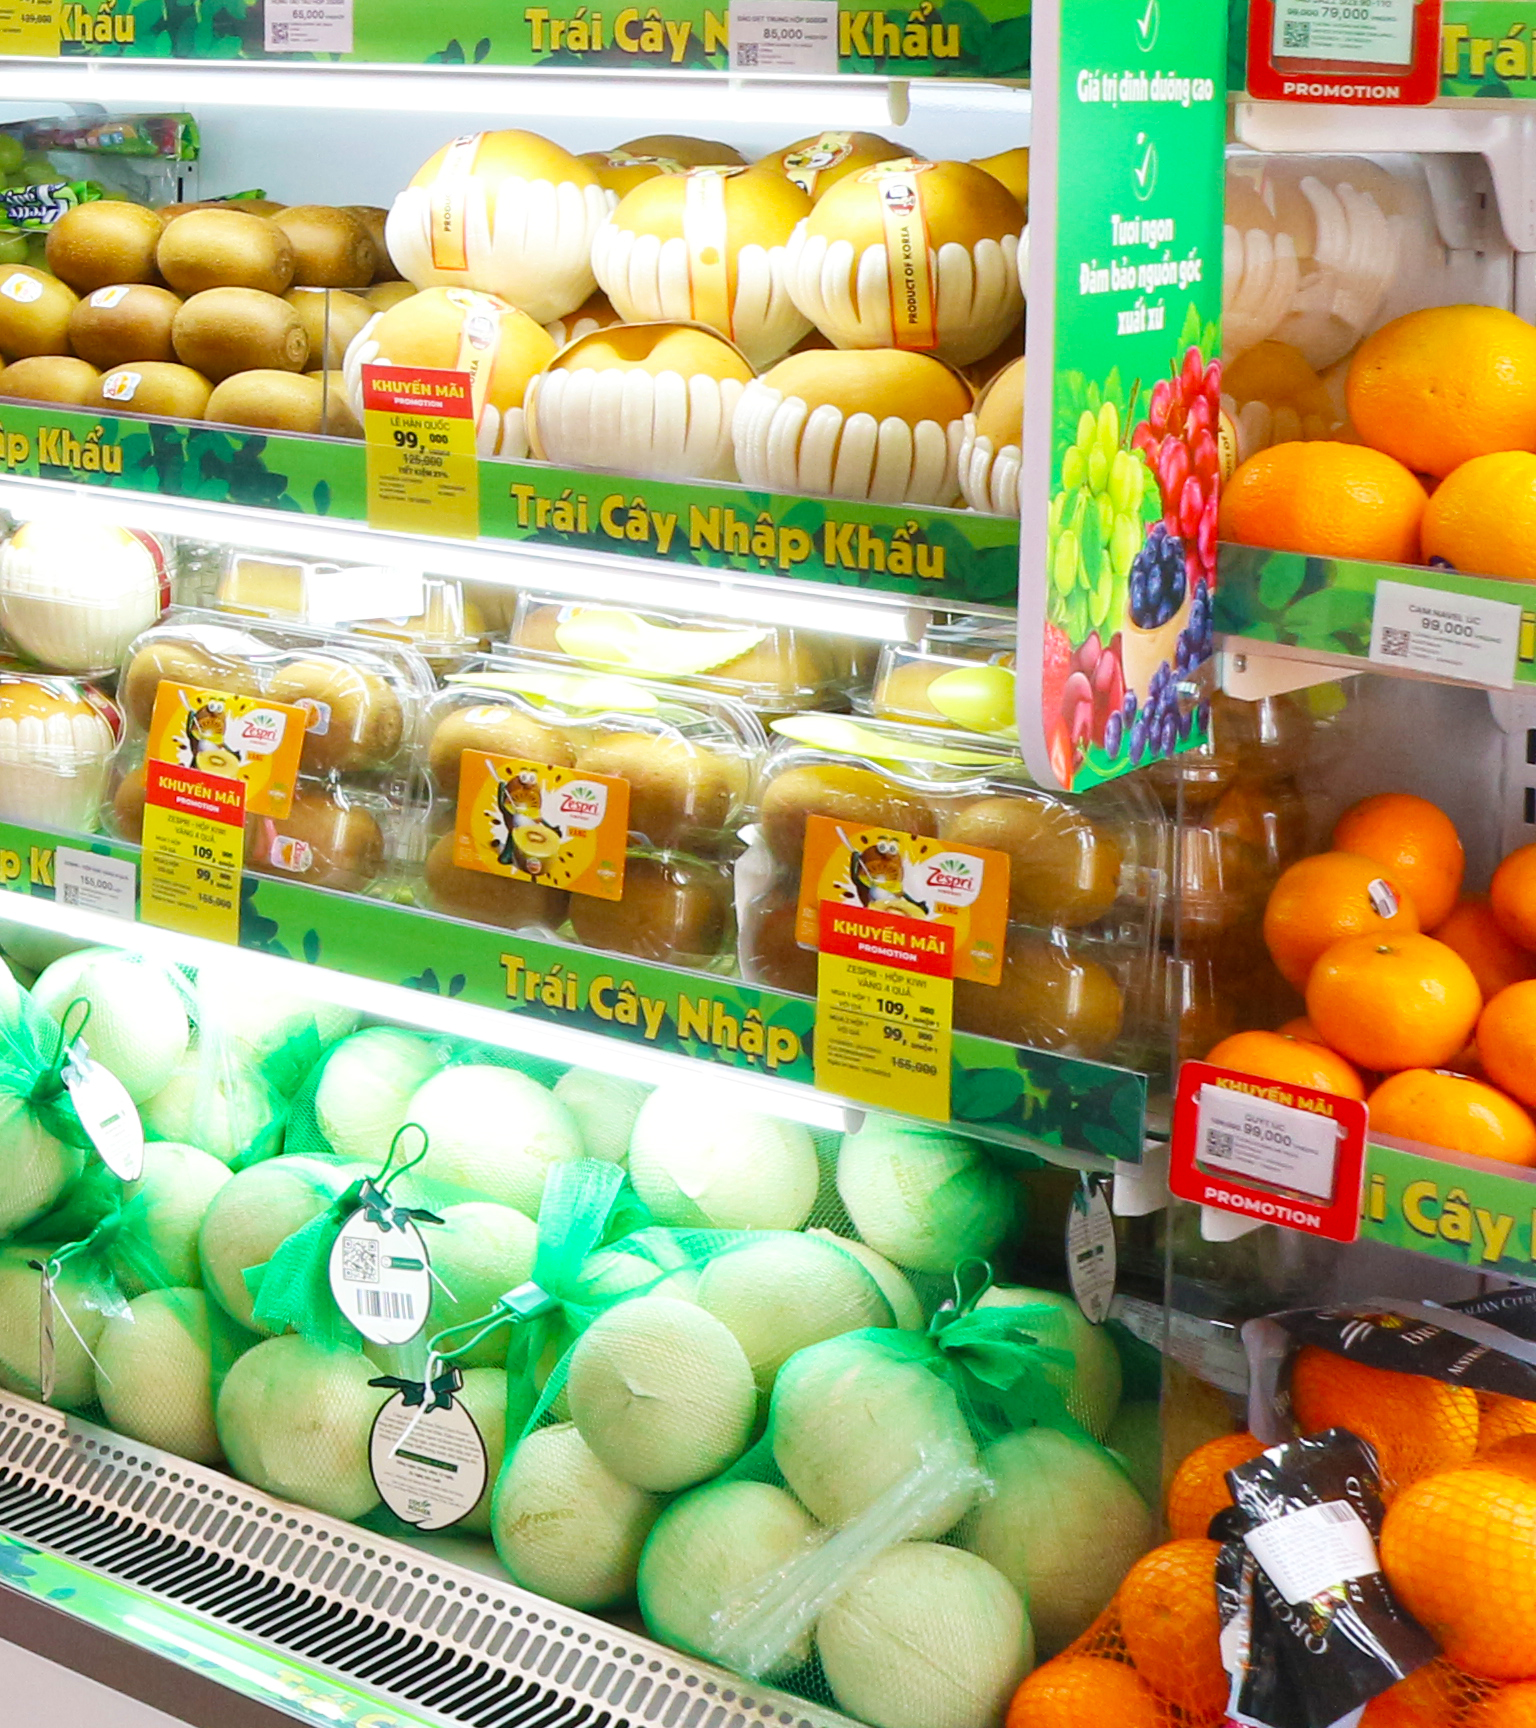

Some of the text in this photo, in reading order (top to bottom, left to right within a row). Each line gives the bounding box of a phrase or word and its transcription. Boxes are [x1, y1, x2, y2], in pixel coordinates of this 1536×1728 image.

[1320, 7, 1369, 21] 79,000
[524, 0, 960, 63] Trái Cây Khẩu
[1077, 69, 1213, 108] Giá trị dinh dưỡng cao
[1283, 82, 1400, 99] PROMOTION
[902, 226, 913, 262] KOREA
[1141, 217, 1174, 244] ngon
[1111, 255, 1136, 291] bảo
[1138, 249, 1177, 292] nguồn
[1179, 246, 1202, 290] gốc
[907, 277, 918, 325] PRODUCT
[372, 378, 465, 398] KHUYẾN MÃI
[403, 419, 422, 429] HÀN
[424, 419, 450, 431] QUỐC
[509, 482, 590, 535] Trái
[598, 492, 677, 556] Cây
[688, 504, 811, 570] Nhập
[822, 518, 945, 580] Khẩu
[1421, 618, 1473, 638] 99,000
[241, 720, 279, 742] Zespri
[159, 776, 241, 807] KHUYẾN MÃI
[559, 794, 599, 817] Zespri
[926, 867, 975, 892] Zespri
[832, 917, 946, 957] KHUYẾN MÃI
[857, 942, 918, 963] PROMOTION
[500, 952, 578, 1011] Trái
[588, 975, 667, 1040] Cây
[677, 992, 799, 1070] Nhập
[1243, 1123, 1292, 1148] 99,000
[1204, 1186, 1321, 1229] PROMOTION
